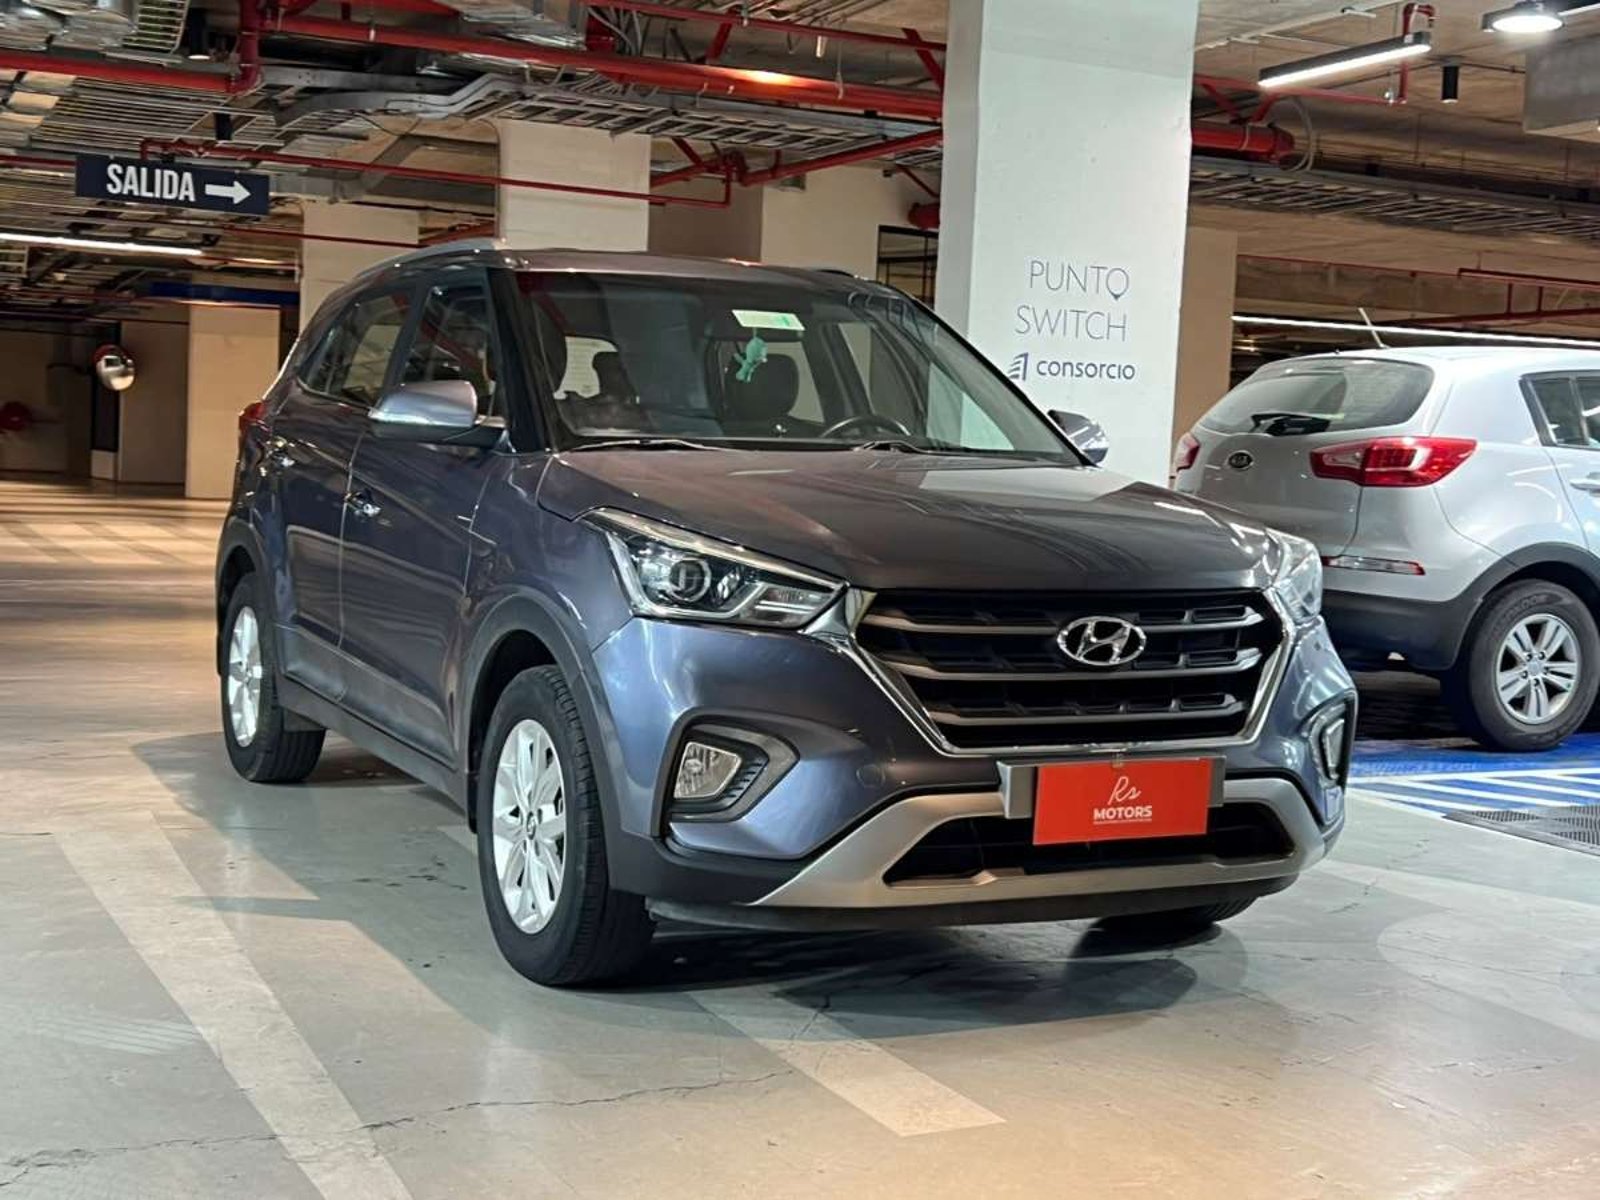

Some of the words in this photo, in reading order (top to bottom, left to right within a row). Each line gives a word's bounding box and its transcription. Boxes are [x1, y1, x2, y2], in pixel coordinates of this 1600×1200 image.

[106, 163, 196, 202] SALIDA
[1029, 259, 1130, 301] PUNTO
[1014, 304, 1127, 342] SWITCH
[1036, 360, 1136, 380] consorcio
[1093, 805, 1152, 820] MOTORS
